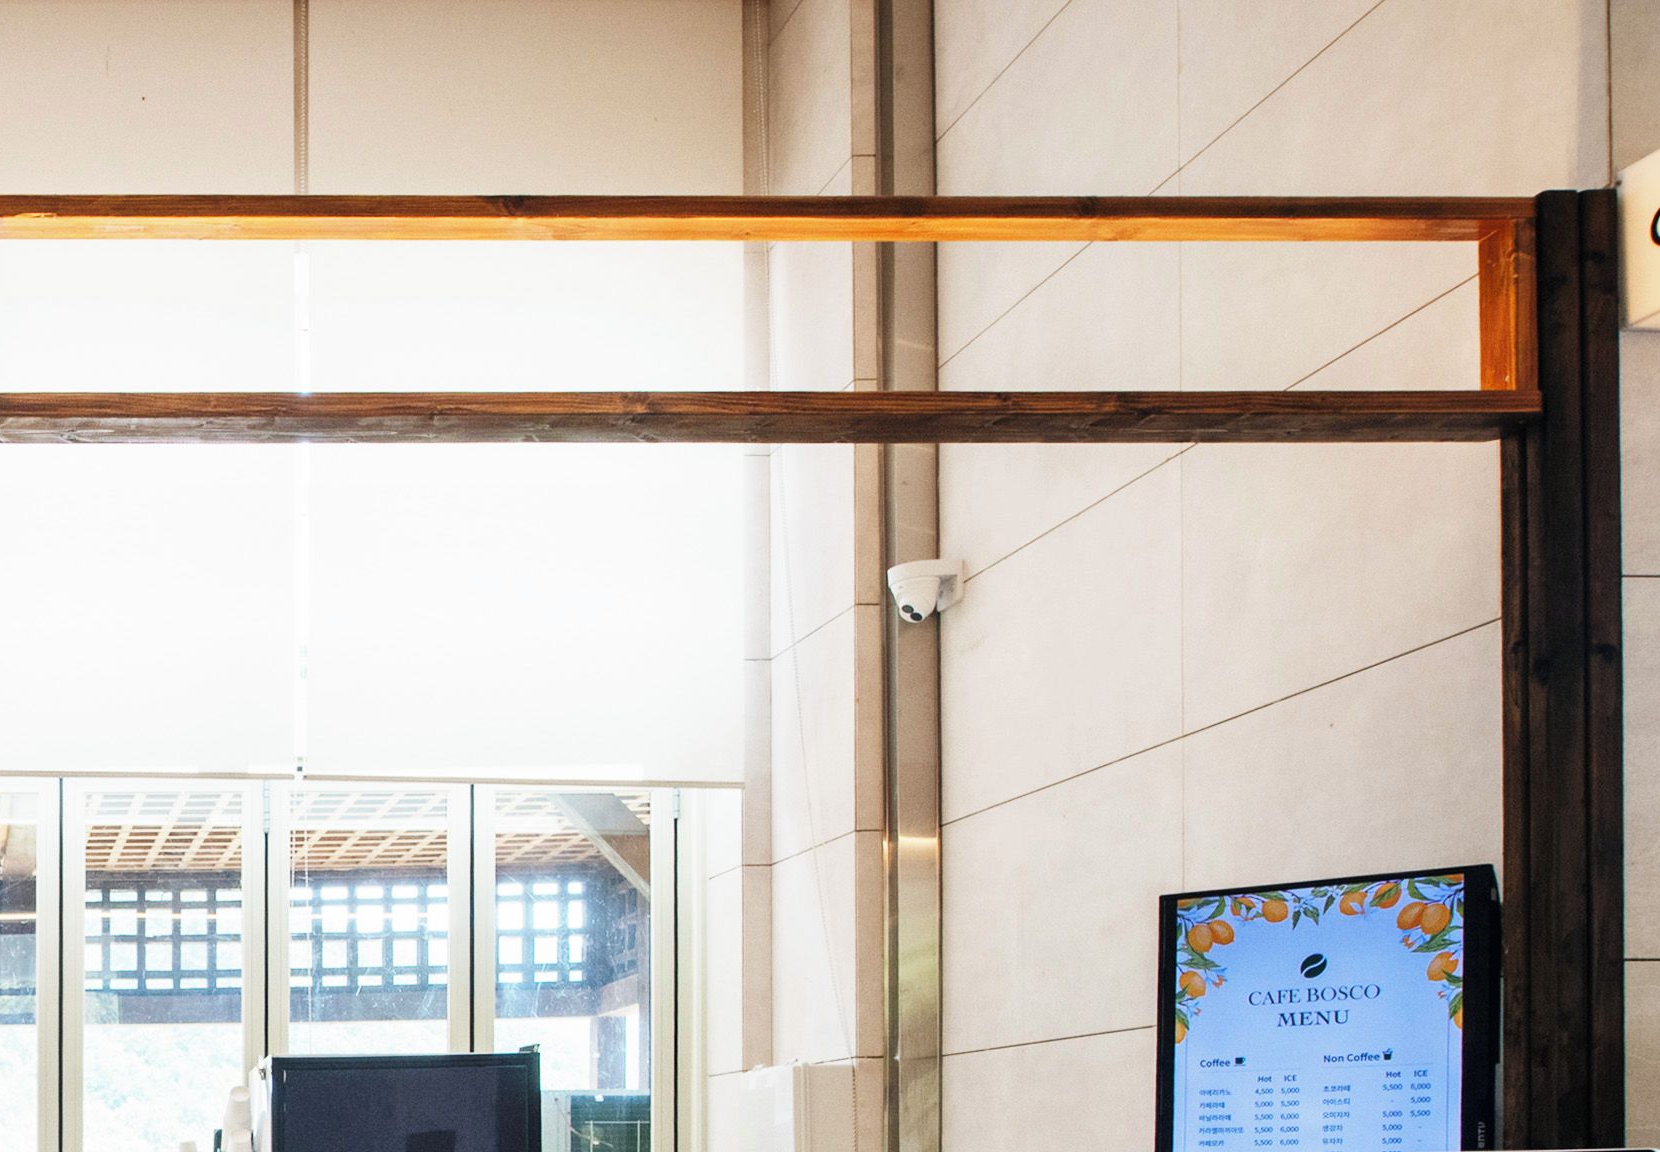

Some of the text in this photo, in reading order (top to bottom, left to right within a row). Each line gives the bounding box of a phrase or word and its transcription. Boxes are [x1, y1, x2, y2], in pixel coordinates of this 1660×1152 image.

[1248, 983, 1381, 1006] CAFE BOSCO
[1276, 1009, 1350, 1029] MENU
[1200, 1058, 1231, 1068] Coffee
[1323, 1052, 1380, 1063] Non Coffee
[1284, 1074, 1297, 1082] ICE
